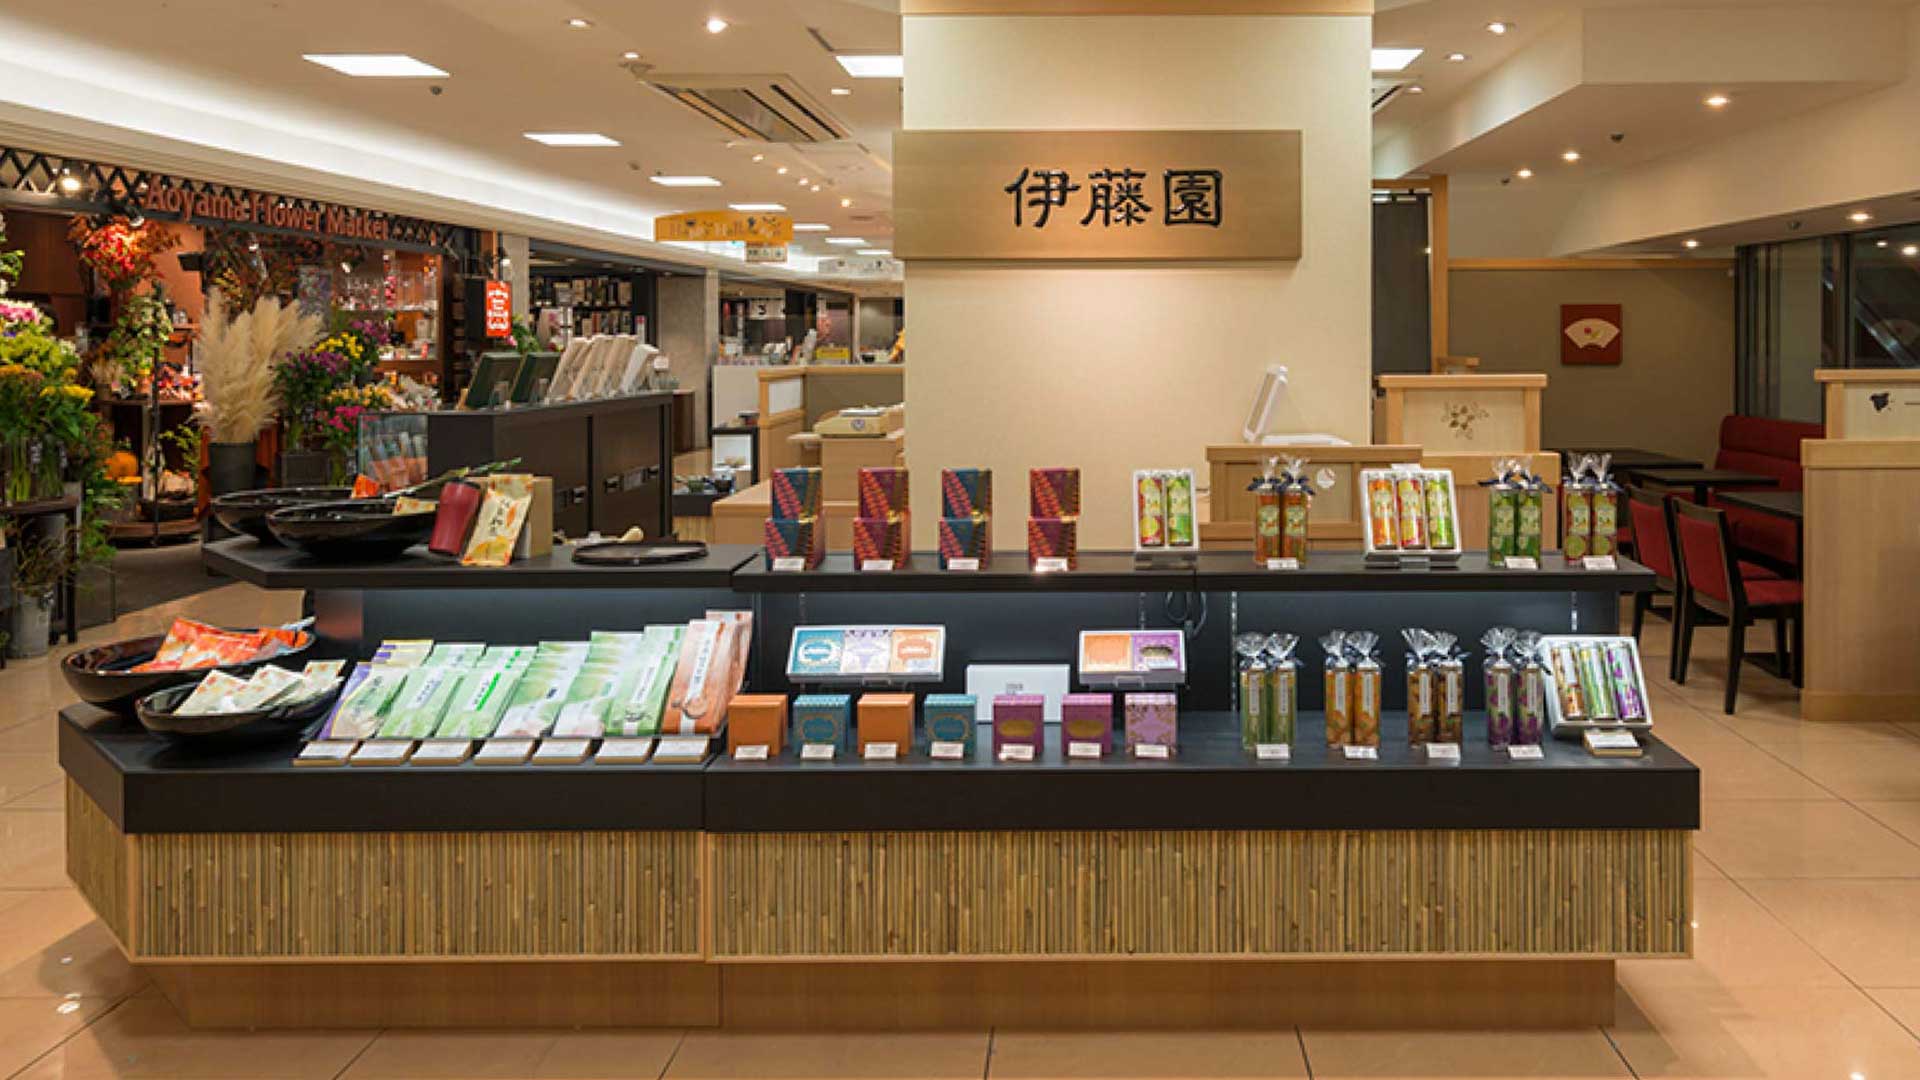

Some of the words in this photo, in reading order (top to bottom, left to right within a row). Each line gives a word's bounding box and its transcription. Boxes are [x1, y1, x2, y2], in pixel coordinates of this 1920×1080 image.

[145, 175, 245, 221] Aoyama
[250, 192, 320, 232] Flower
[327, 203, 389, 240] Market
[1004, 167, 1223, 228] 伊藤園
